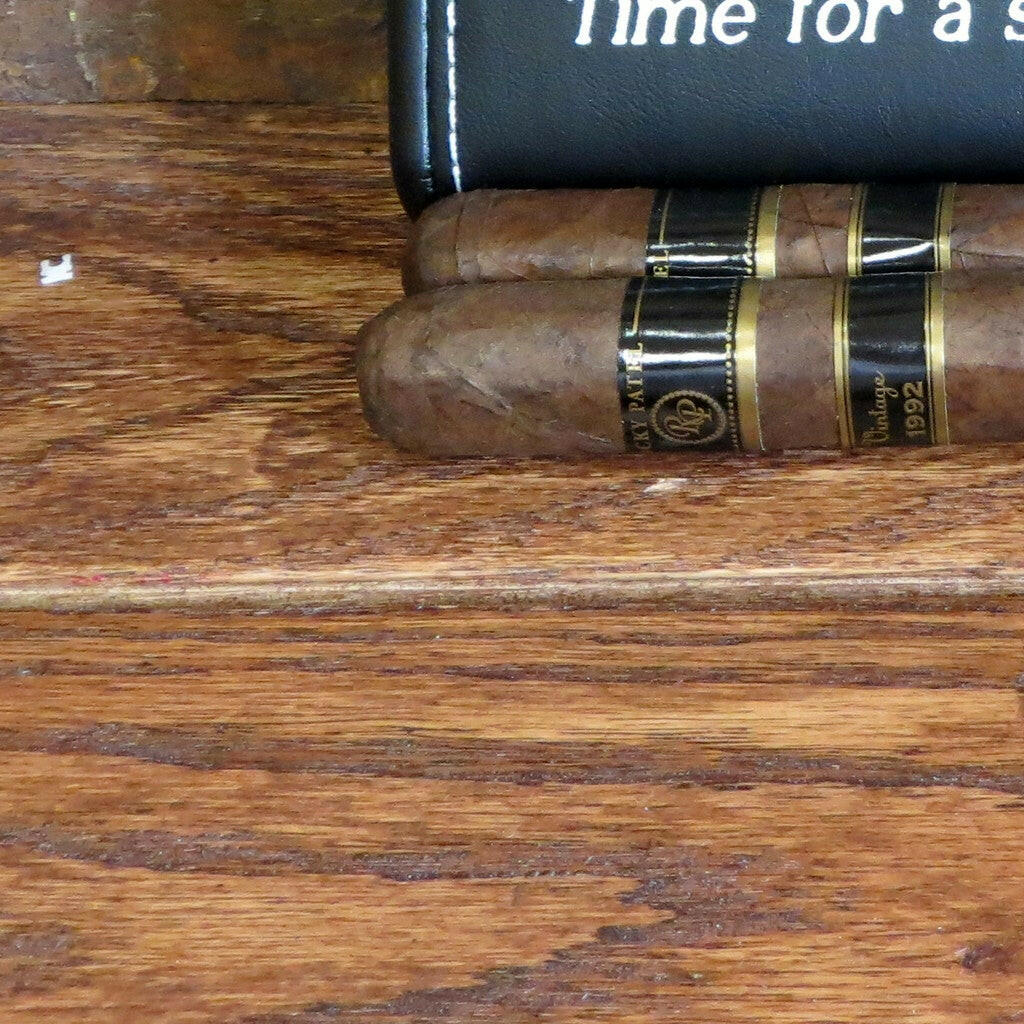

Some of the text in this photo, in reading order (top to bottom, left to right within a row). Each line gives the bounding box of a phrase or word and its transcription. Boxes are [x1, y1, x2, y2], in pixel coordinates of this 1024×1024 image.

[630, 419, 652, 450] CKY
[861, 369, 900, 444] Vintage
[903, 380, 925, 438] 1992
